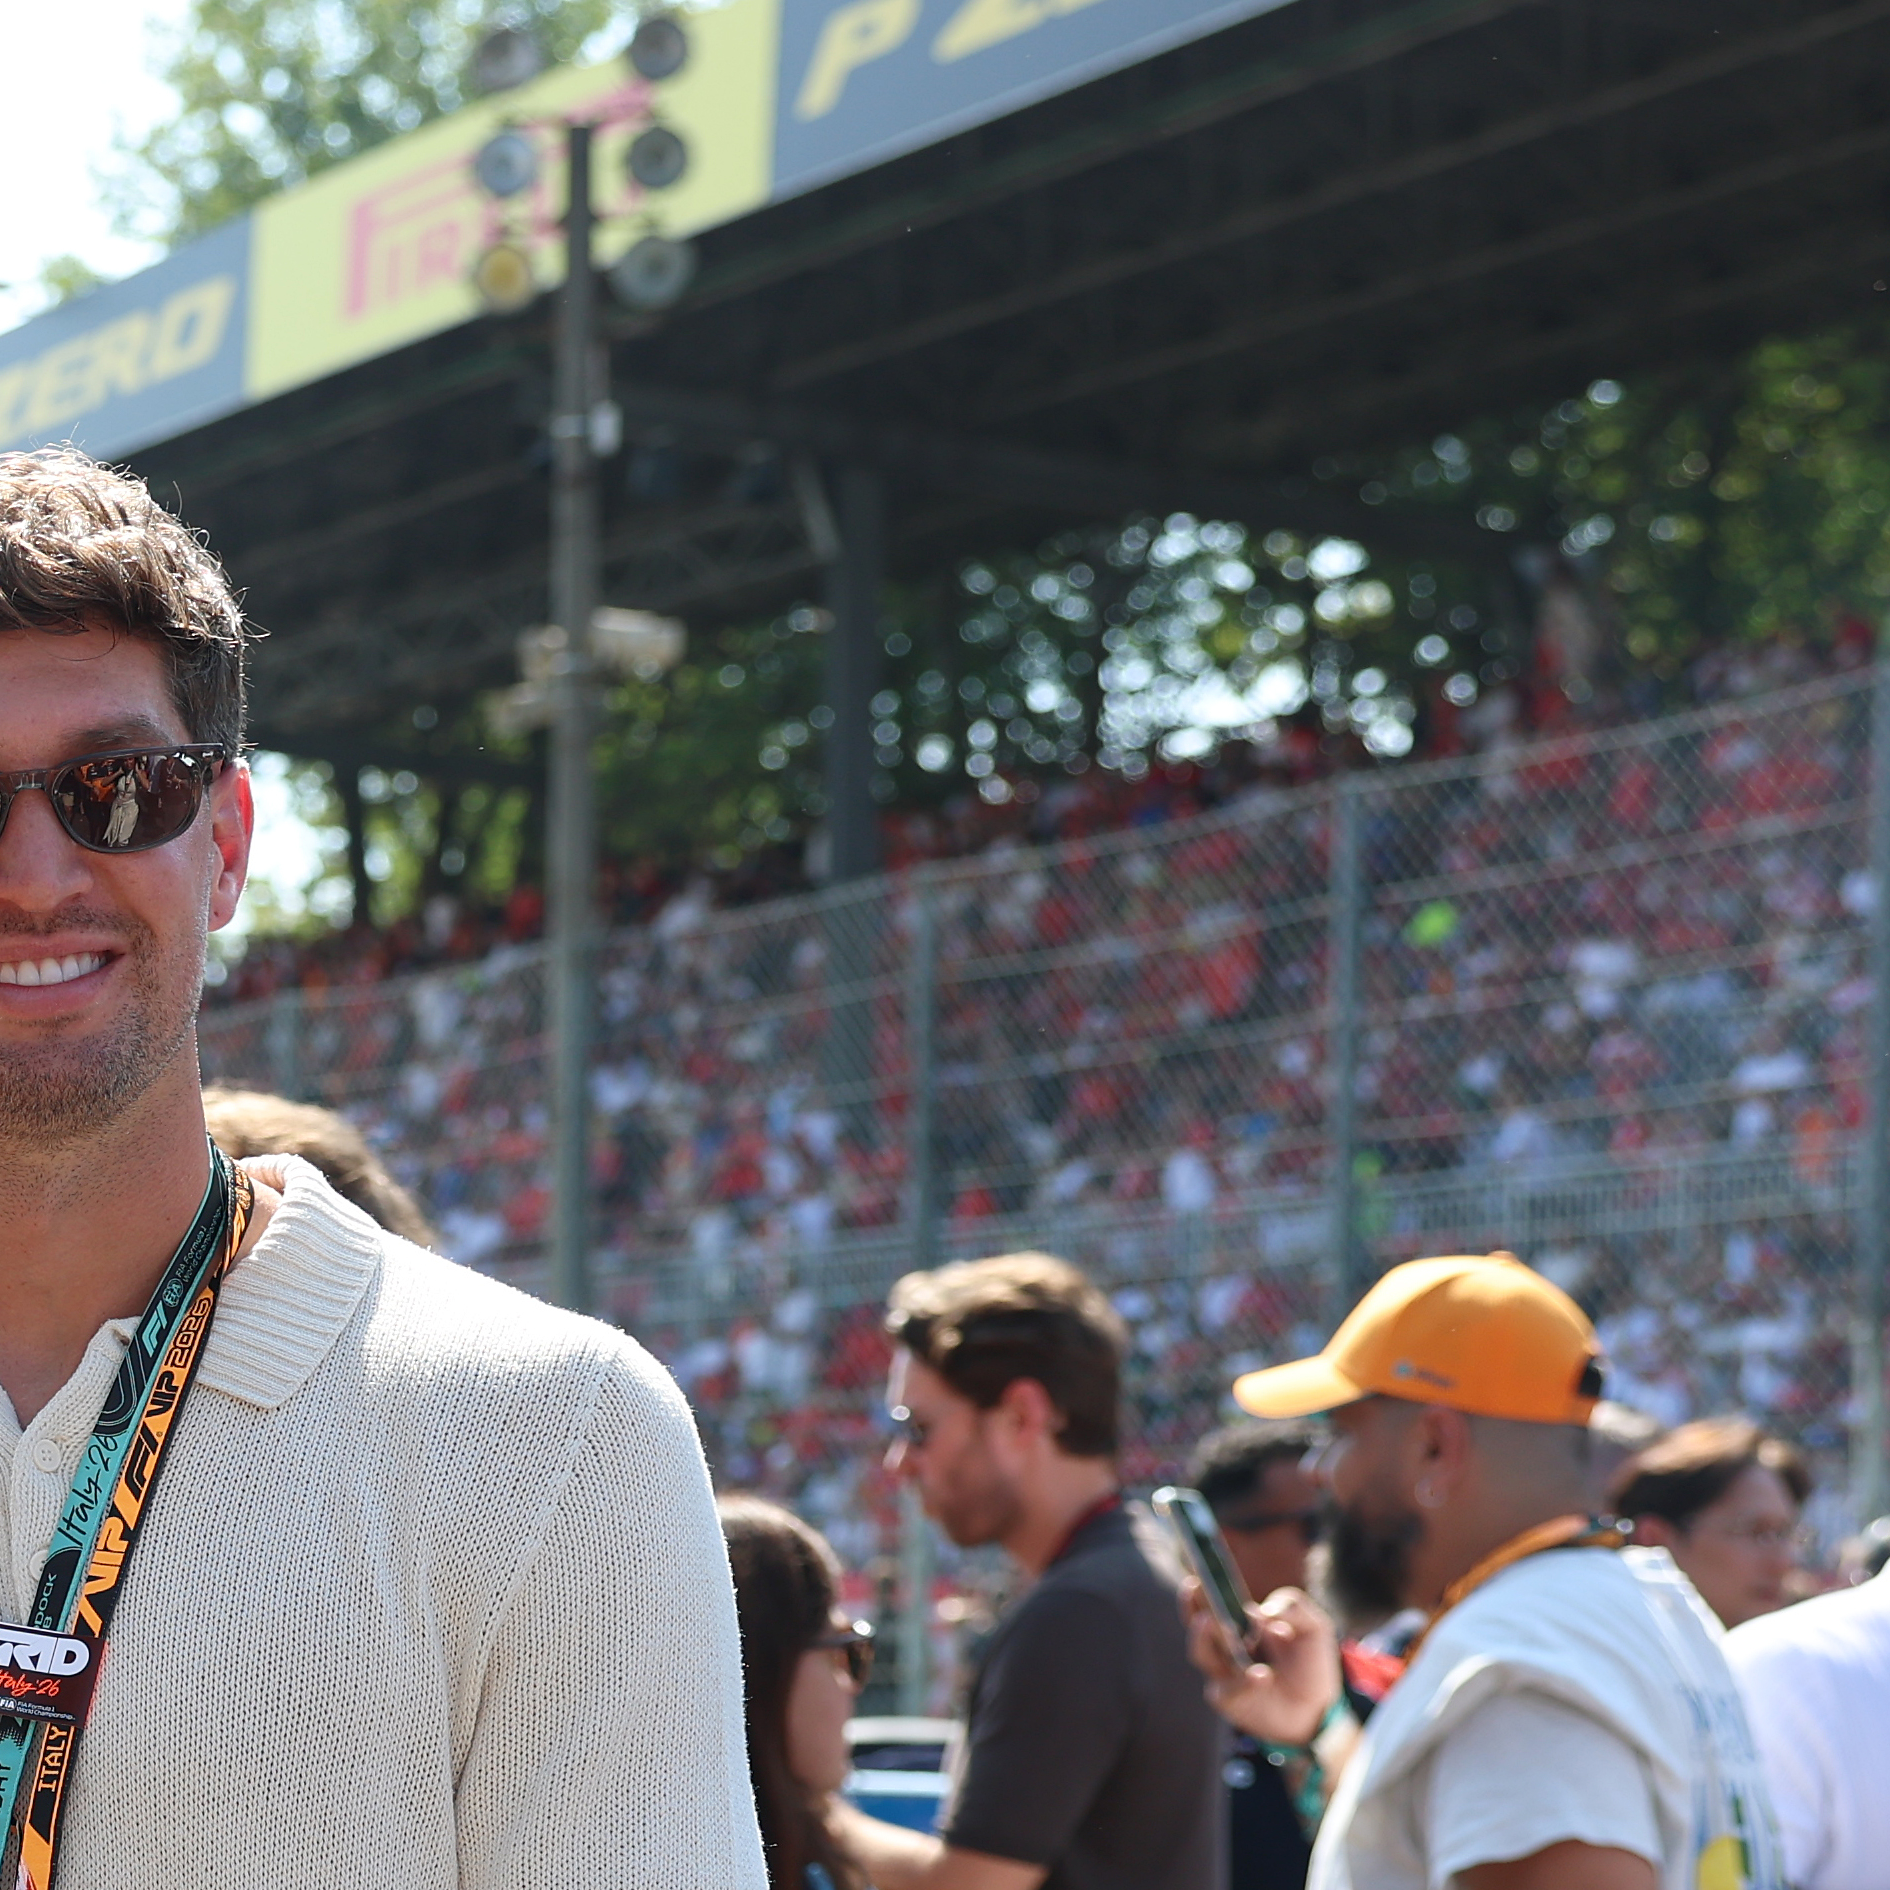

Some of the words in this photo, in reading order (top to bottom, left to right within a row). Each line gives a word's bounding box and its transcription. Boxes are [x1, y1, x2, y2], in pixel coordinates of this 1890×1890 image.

[145, 1370, 180, 1418] VIP
[164, 1297, 212, 1370] 2026
[16, 1706, 33, 1715] World
[28, 1703, 51, 1712] Formula
[37, 1726, 68, 1793] ITALY
